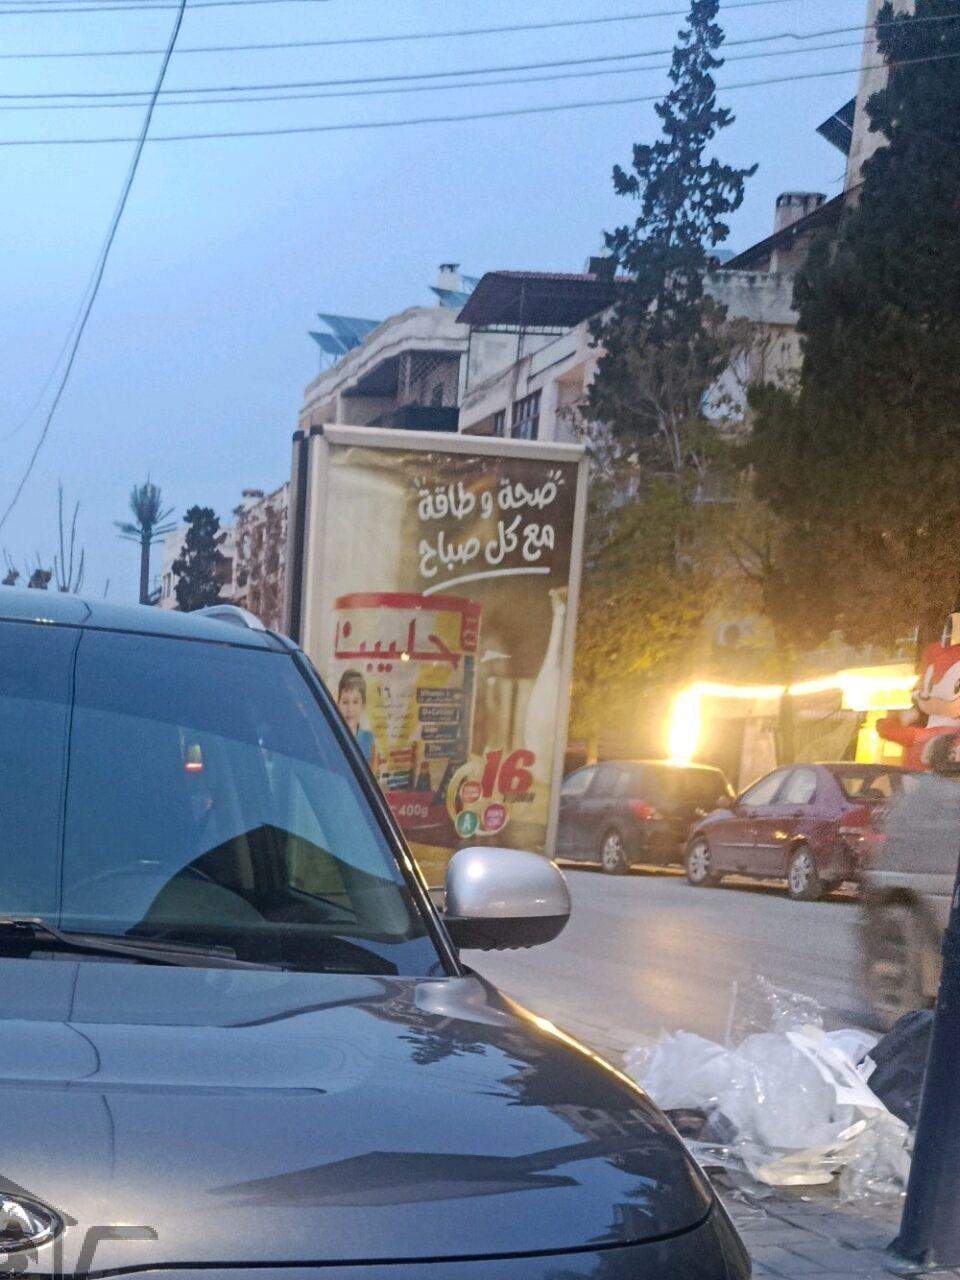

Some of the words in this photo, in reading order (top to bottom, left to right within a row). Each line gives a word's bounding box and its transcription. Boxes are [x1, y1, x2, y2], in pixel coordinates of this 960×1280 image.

[418, 481, 476, 520] طاقة
[481, 491, 493, 519] و
[498, 477, 557, 510] صحة
[419, 531, 480, 578] صباح
[485, 514, 522, 564] كل
[523, 523, 555, 561] مع
[482, 748, 536, 798] 16
[398, 804, 429, 818] 400g
